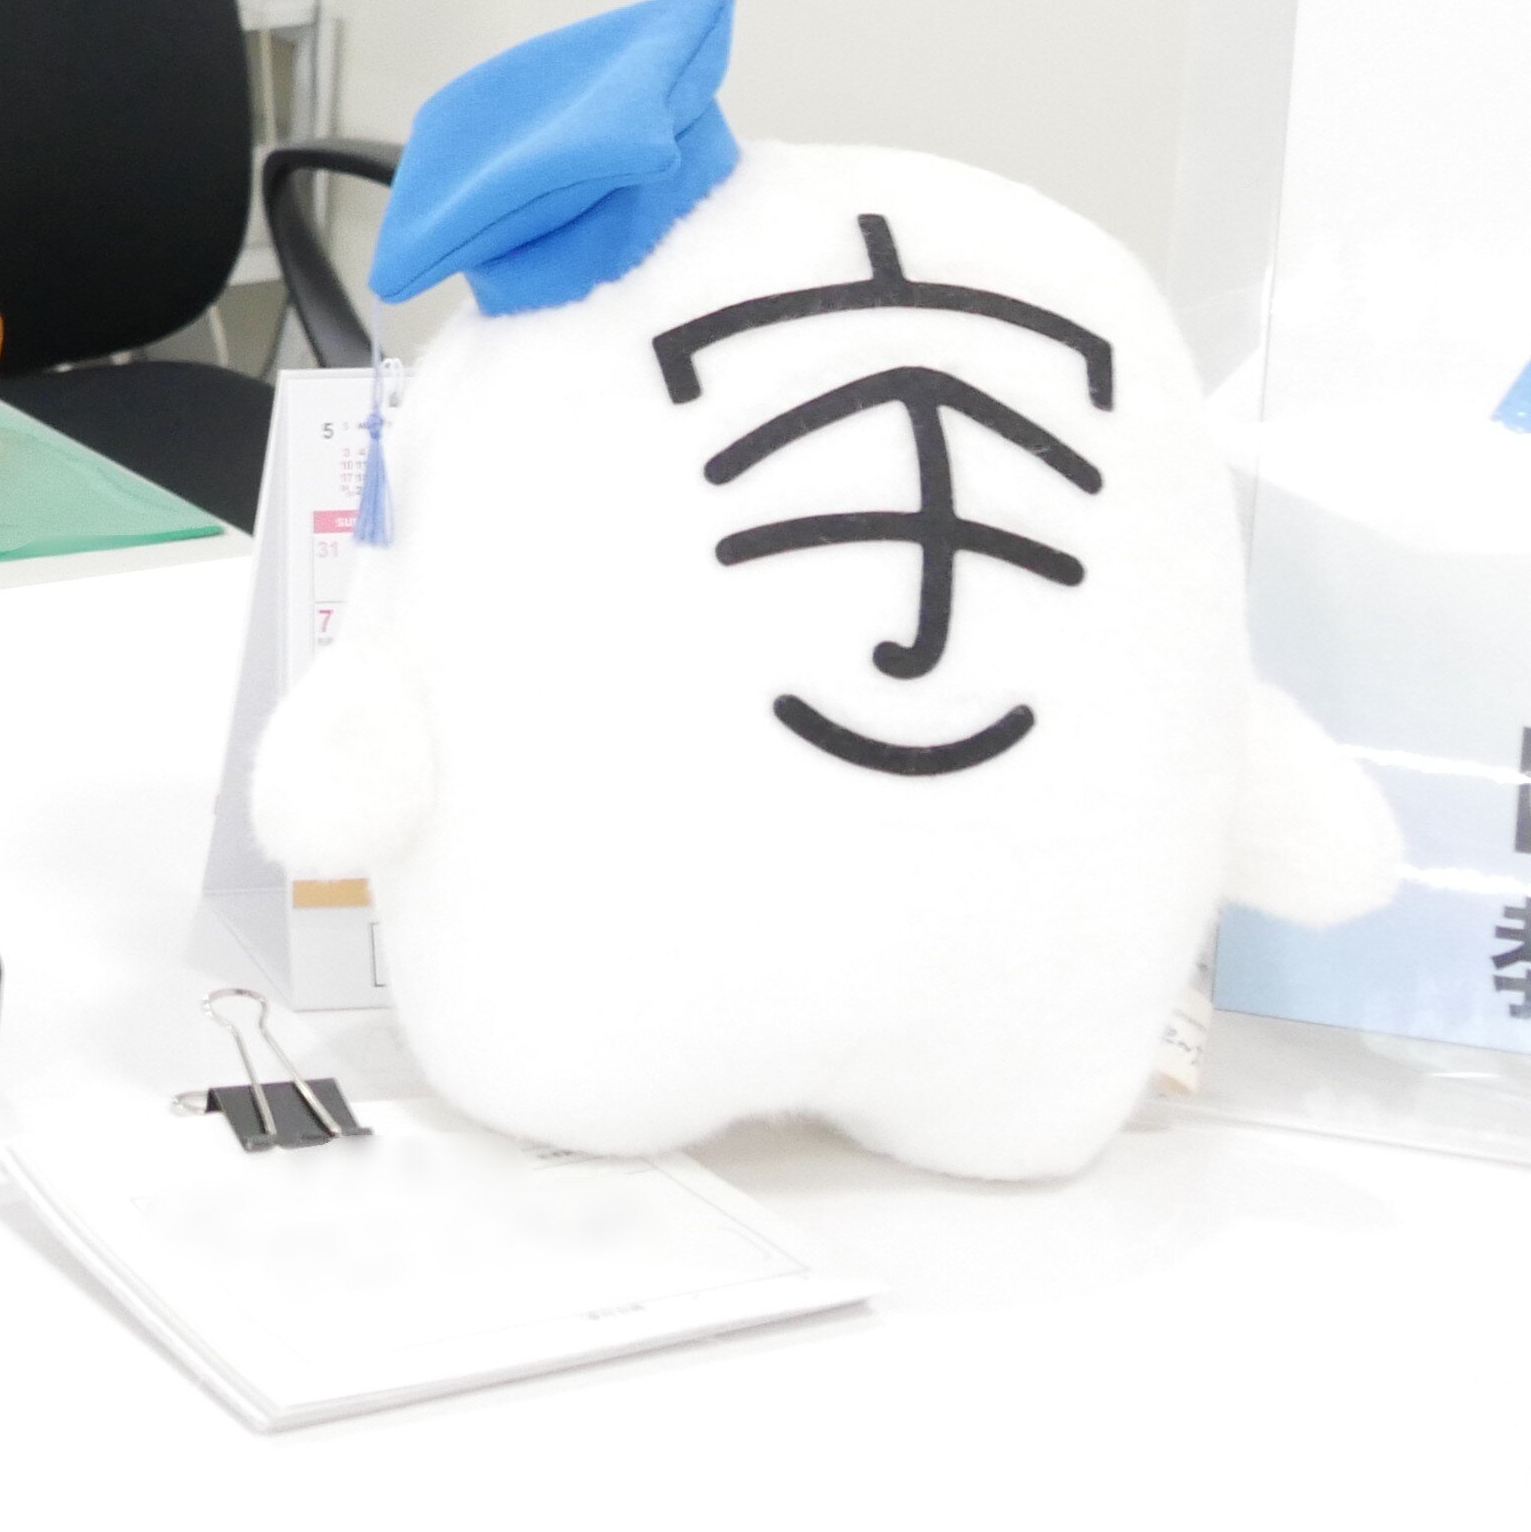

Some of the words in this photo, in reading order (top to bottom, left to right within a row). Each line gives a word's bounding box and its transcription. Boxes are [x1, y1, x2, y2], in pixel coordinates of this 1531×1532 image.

[323, 422, 335, 439] 5
[317, 541, 339, 558] 31
[318, 609, 333, 633] 7
